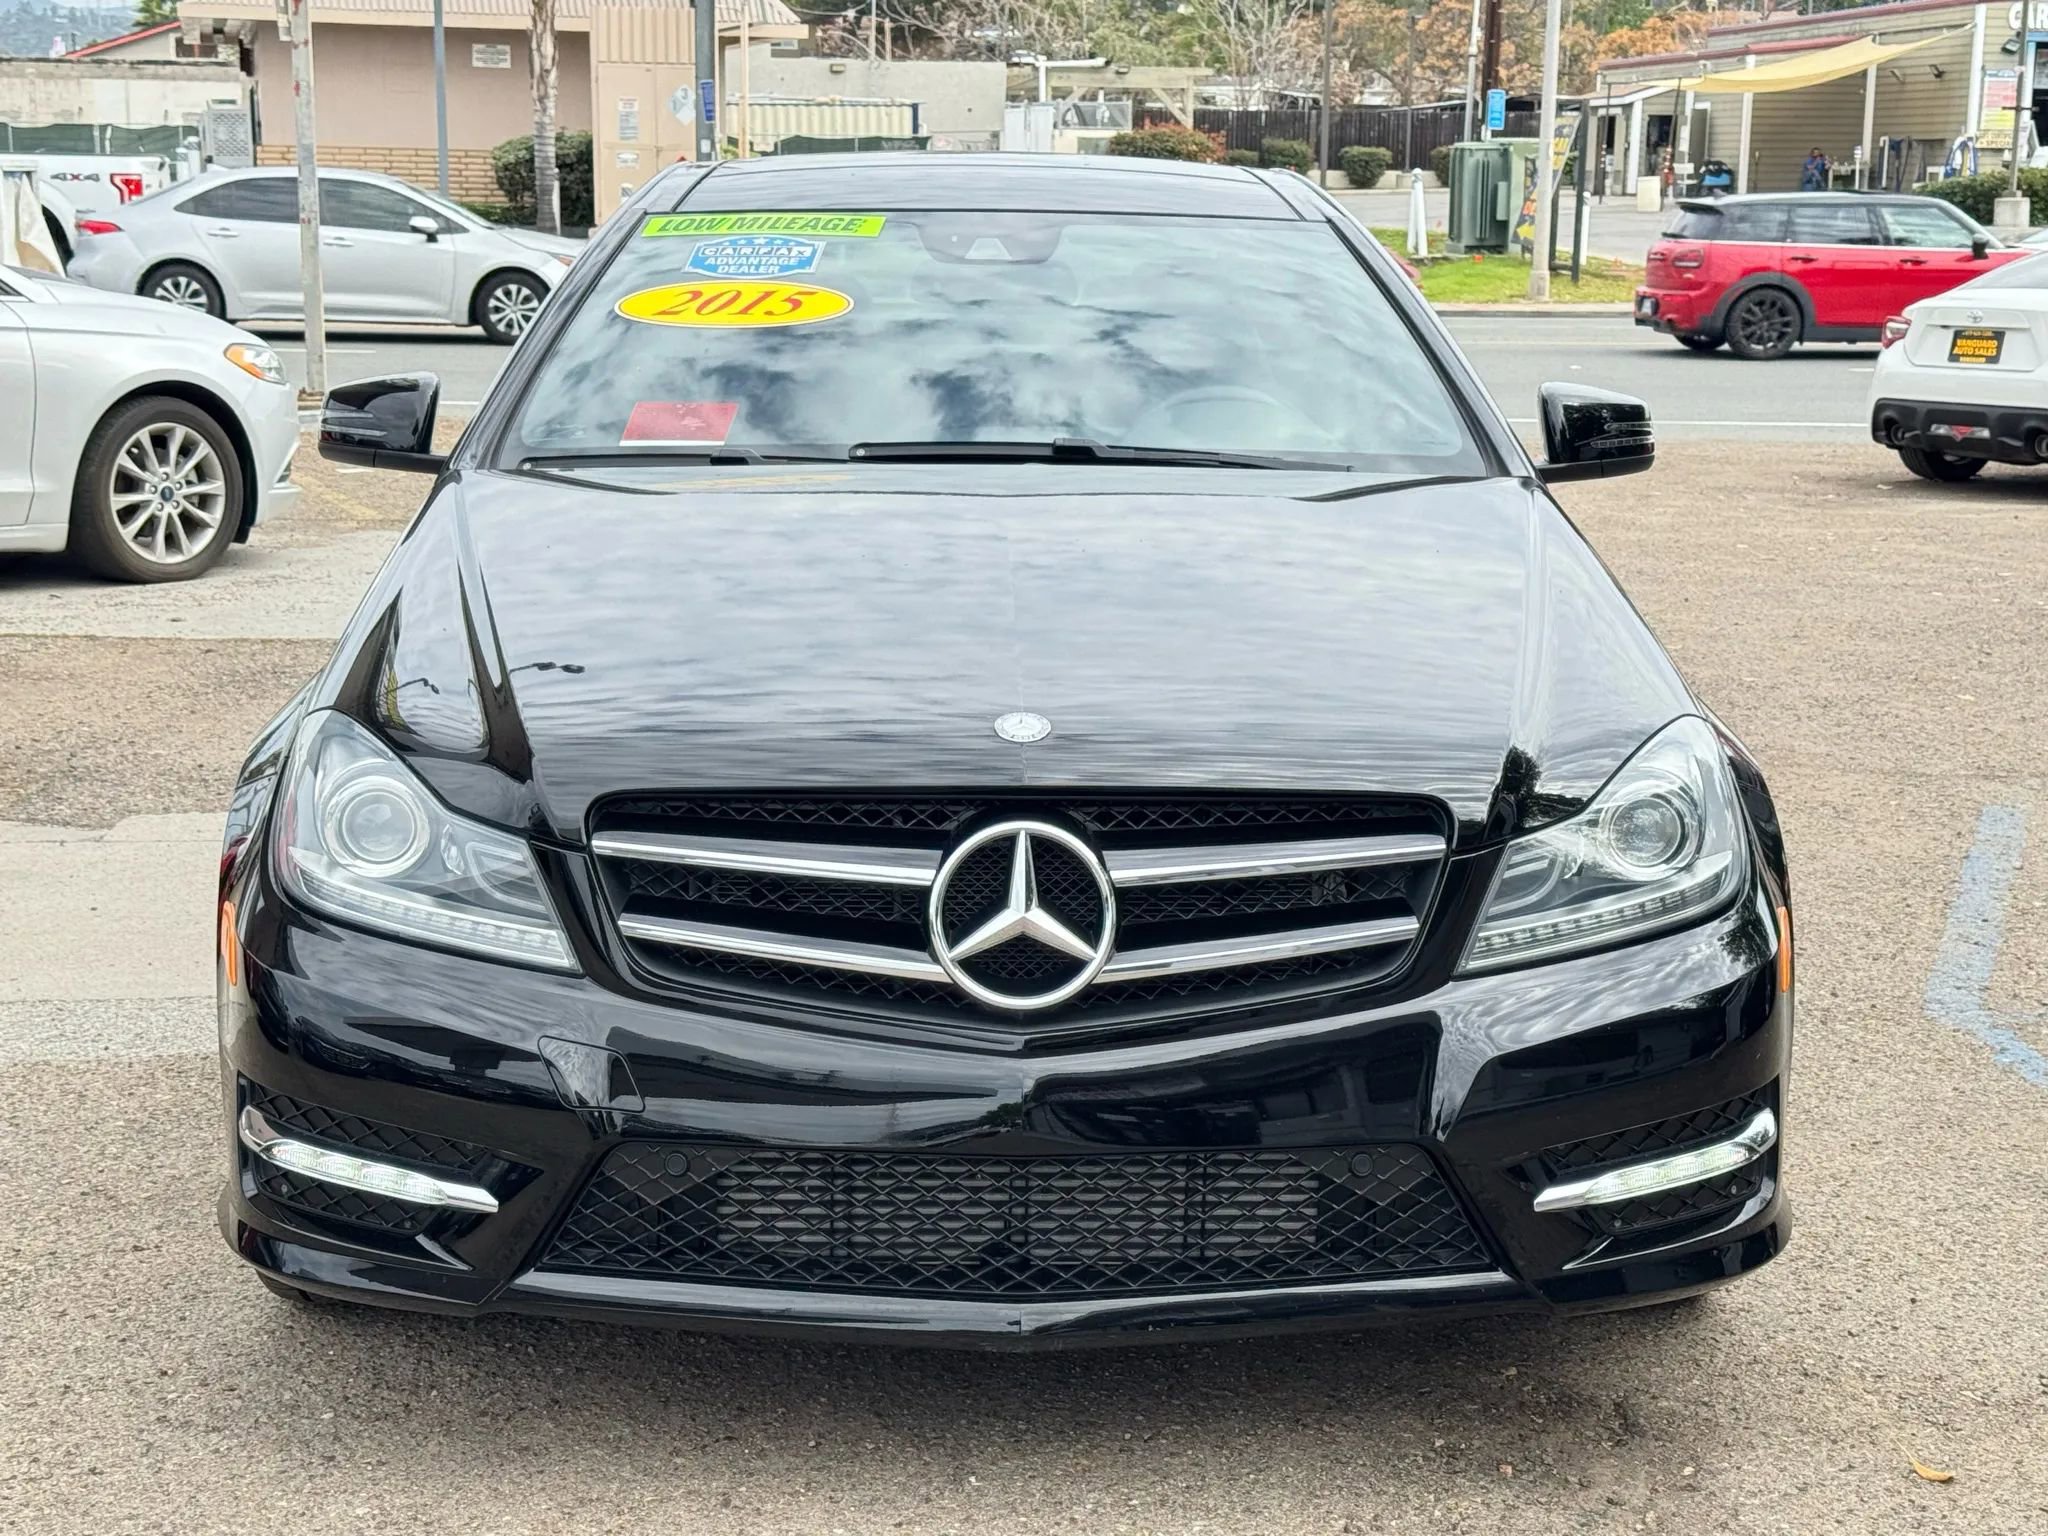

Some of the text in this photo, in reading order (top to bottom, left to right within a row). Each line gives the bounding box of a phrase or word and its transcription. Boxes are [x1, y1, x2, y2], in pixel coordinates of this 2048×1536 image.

[657, 216, 864, 233] LOW MILEAGE
[700, 245, 811, 257] CARFAX
[704, 256, 800, 266] ADVANTAGE
[716, 265, 781, 275] DEALER
[652, 289, 819, 317] 2015
[1957, 339, 1997, 348] VANGUARD
[1952, 347, 1997, 356] AUTO SALES
